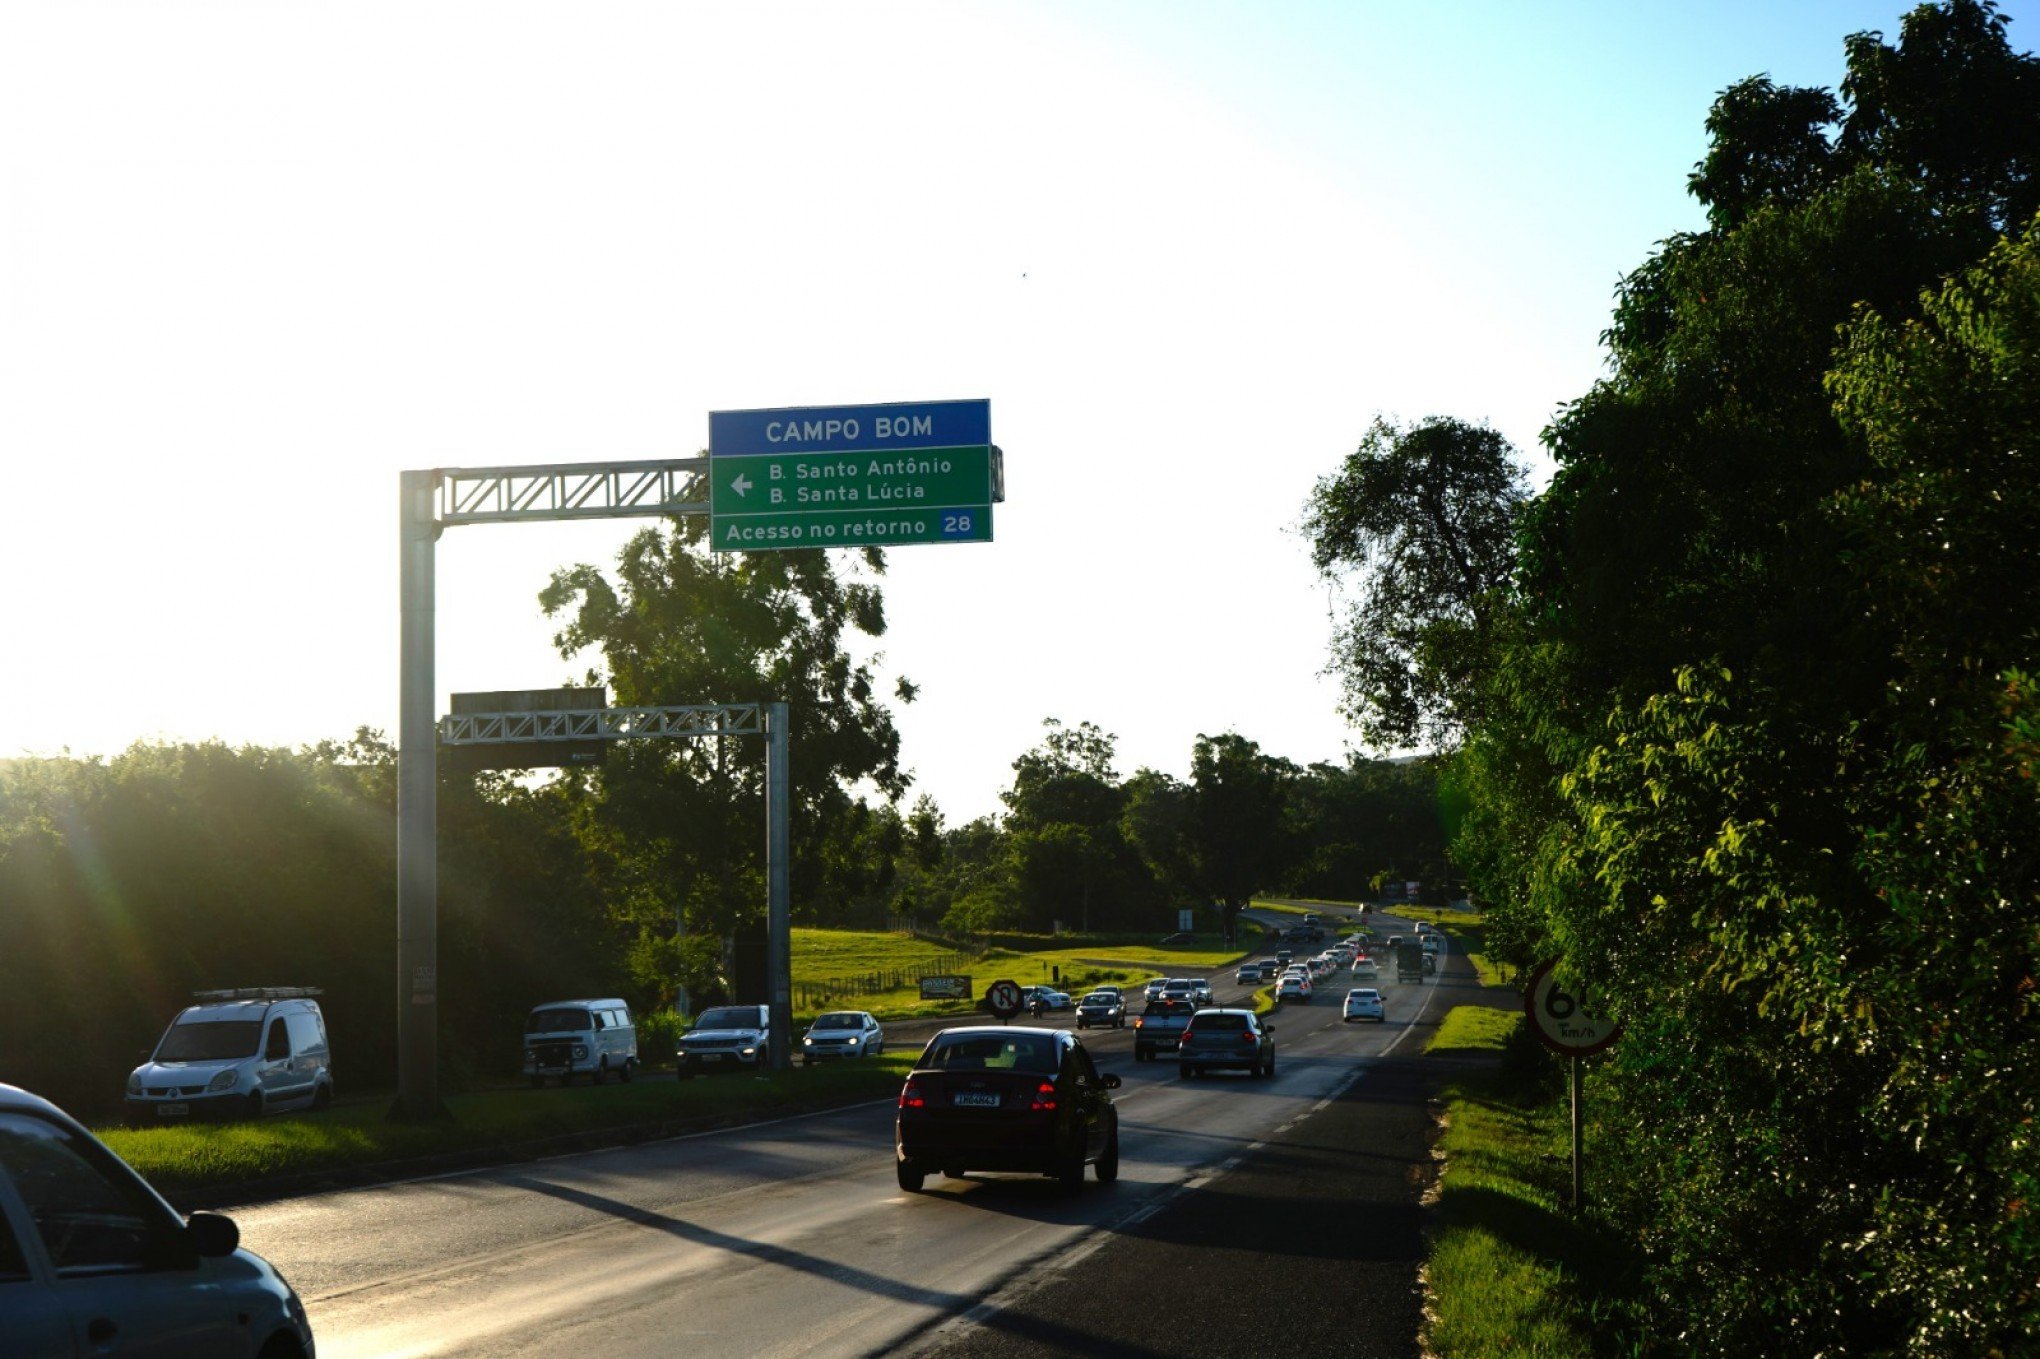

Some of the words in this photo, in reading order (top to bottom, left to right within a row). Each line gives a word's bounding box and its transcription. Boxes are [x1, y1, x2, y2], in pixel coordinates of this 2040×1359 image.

[766, 419, 859, 442] CAMPO
[875, 415, 932, 438] BOM
[770, 464, 786, 480] B.
[796, 461, 858, 479] Santo
[867, 457, 952, 476] Antônio
[770, 488, 787, 504] B.
[797, 485, 859, 502] Santa
[867, 481, 925, 499] Lúcia
[725, 524, 802, 541] Acesso
[810, 522, 835, 538] no
[843, 518, 926, 536] retorno
[944, 516, 971, 533] 28
